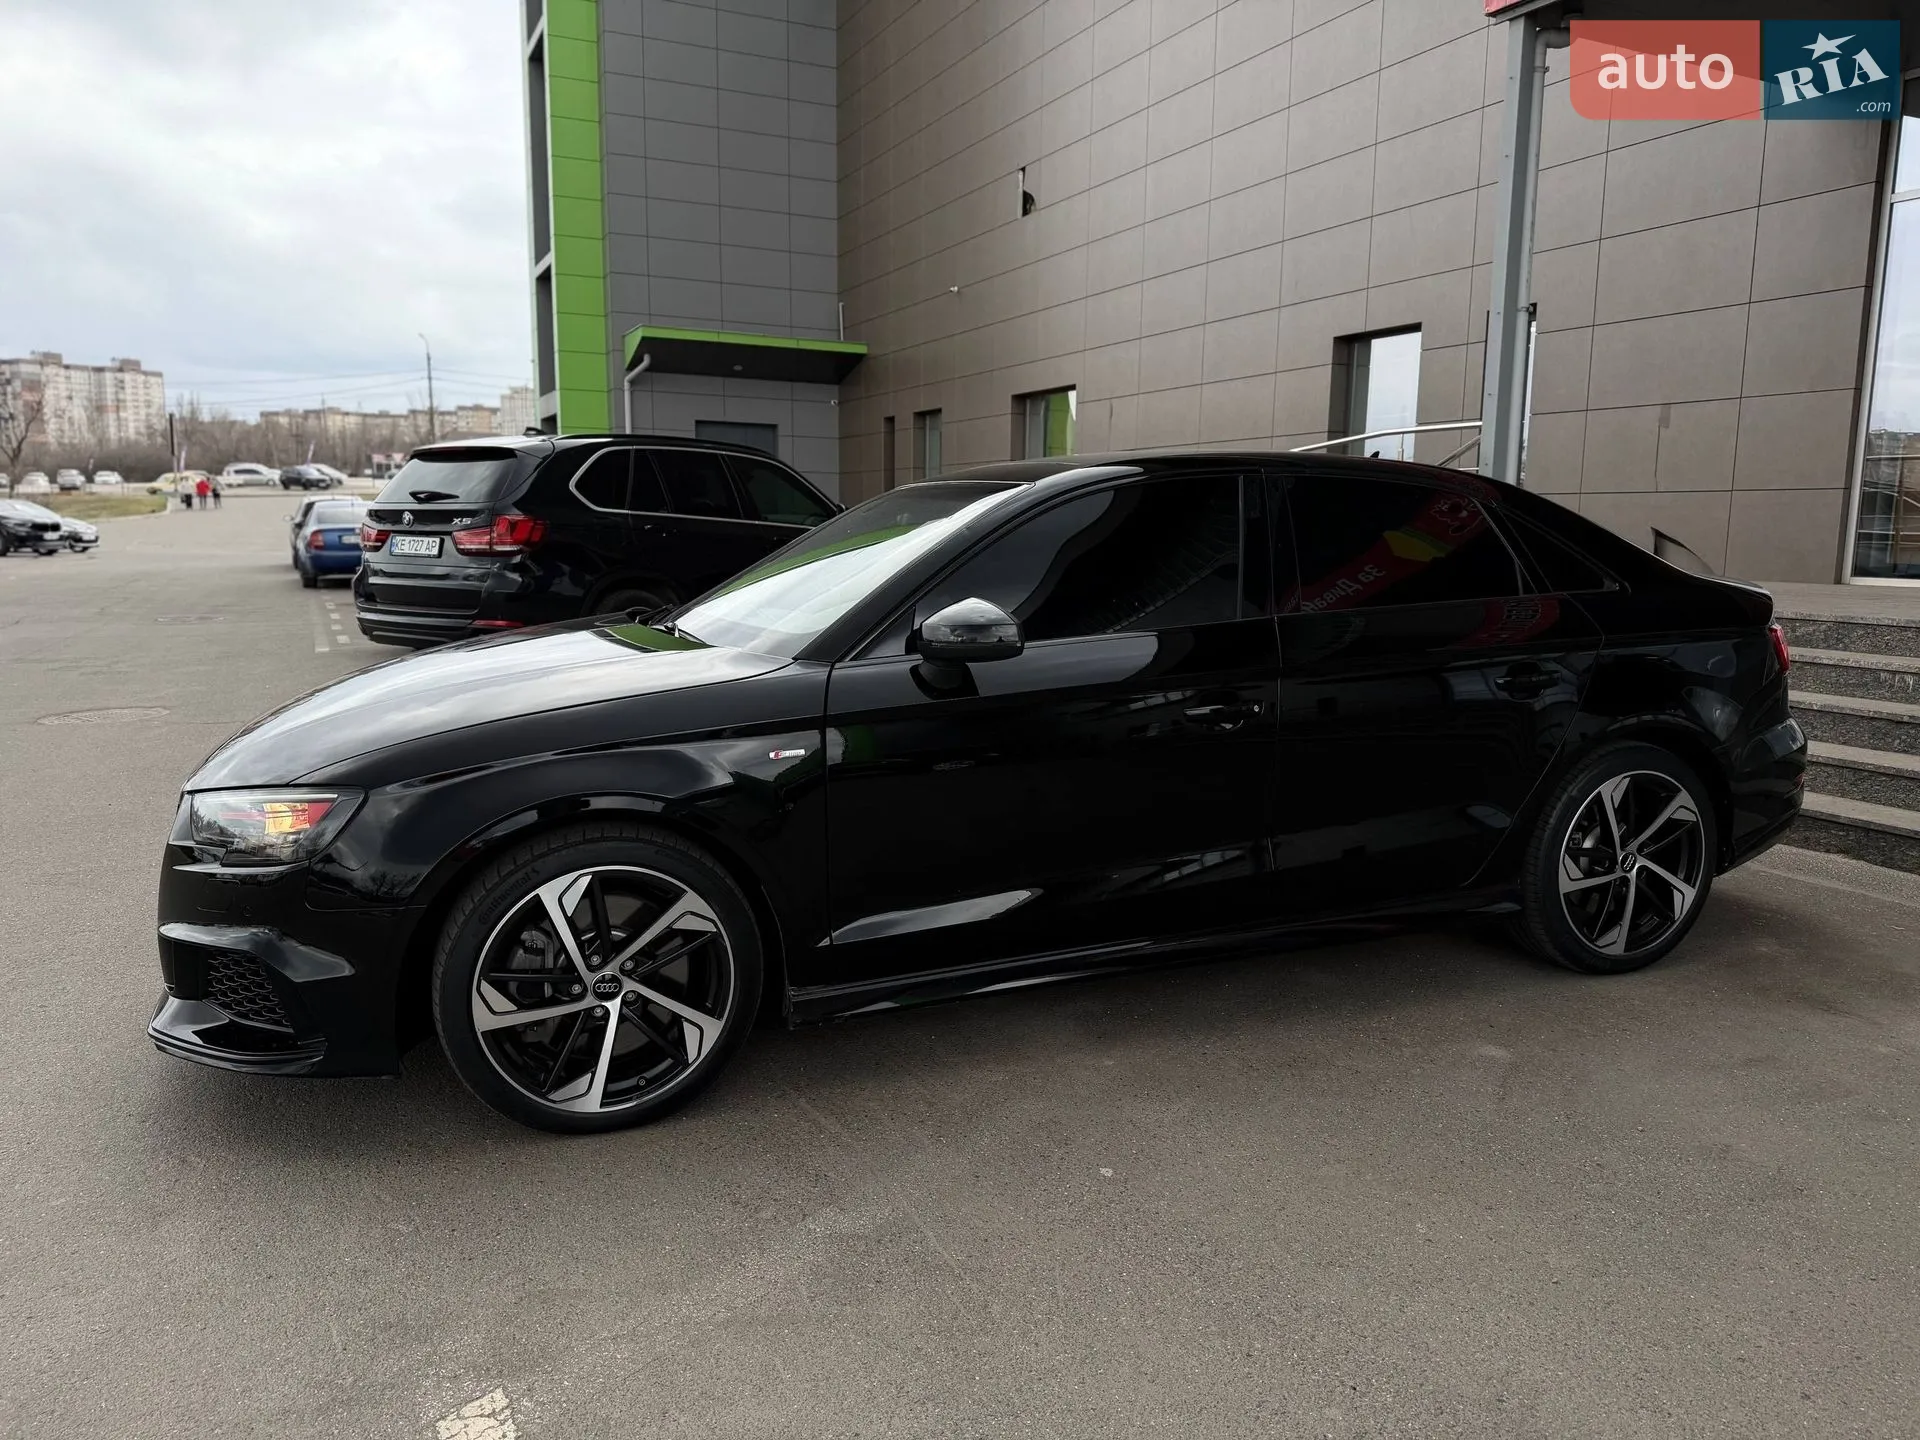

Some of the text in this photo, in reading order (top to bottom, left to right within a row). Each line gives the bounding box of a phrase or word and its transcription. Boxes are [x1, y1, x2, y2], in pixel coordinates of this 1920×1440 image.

[451, 517, 472, 526] X5
[395, 537, 437, 553] KE 1727 AP
